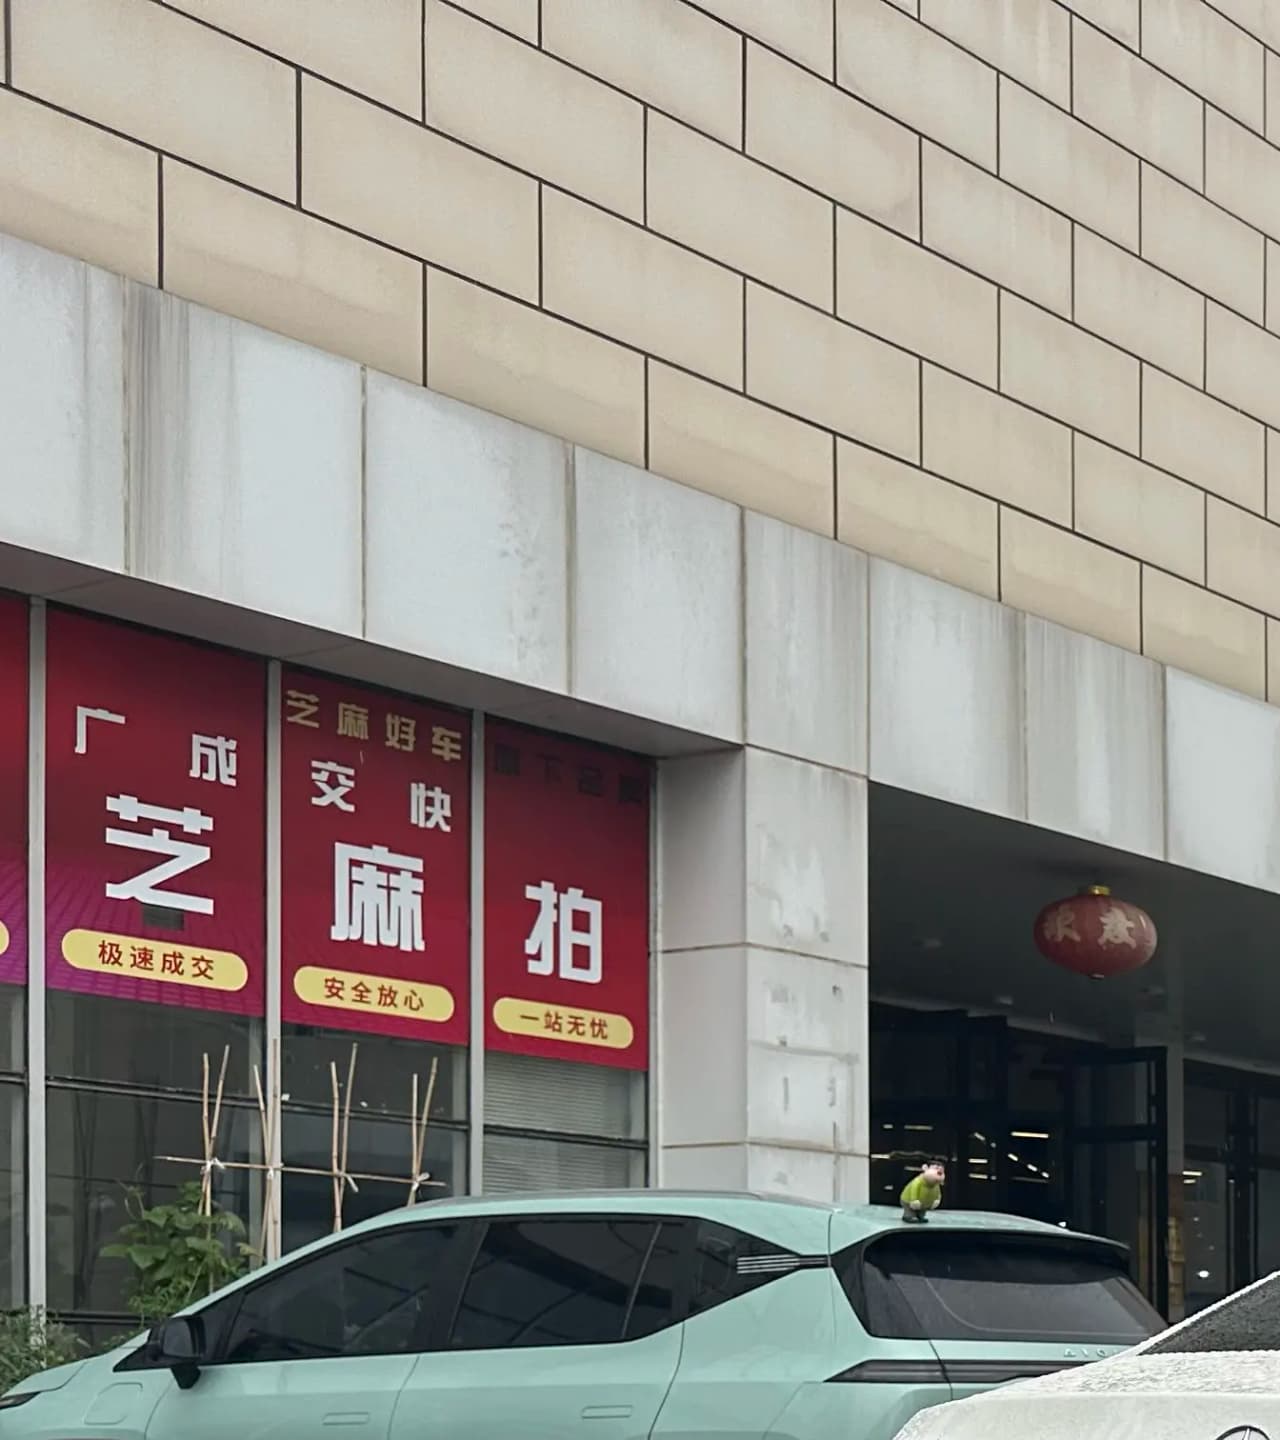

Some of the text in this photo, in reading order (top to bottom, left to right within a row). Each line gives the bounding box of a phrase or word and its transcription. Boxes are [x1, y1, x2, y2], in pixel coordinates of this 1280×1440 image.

[286, 690, 462, 762] 芝麻好车
[97, 939, 216, 982] 极速成交
[323, 977, 425, 1013] 安全放心
[519, 1010, 609, 1041] 一站无忧
